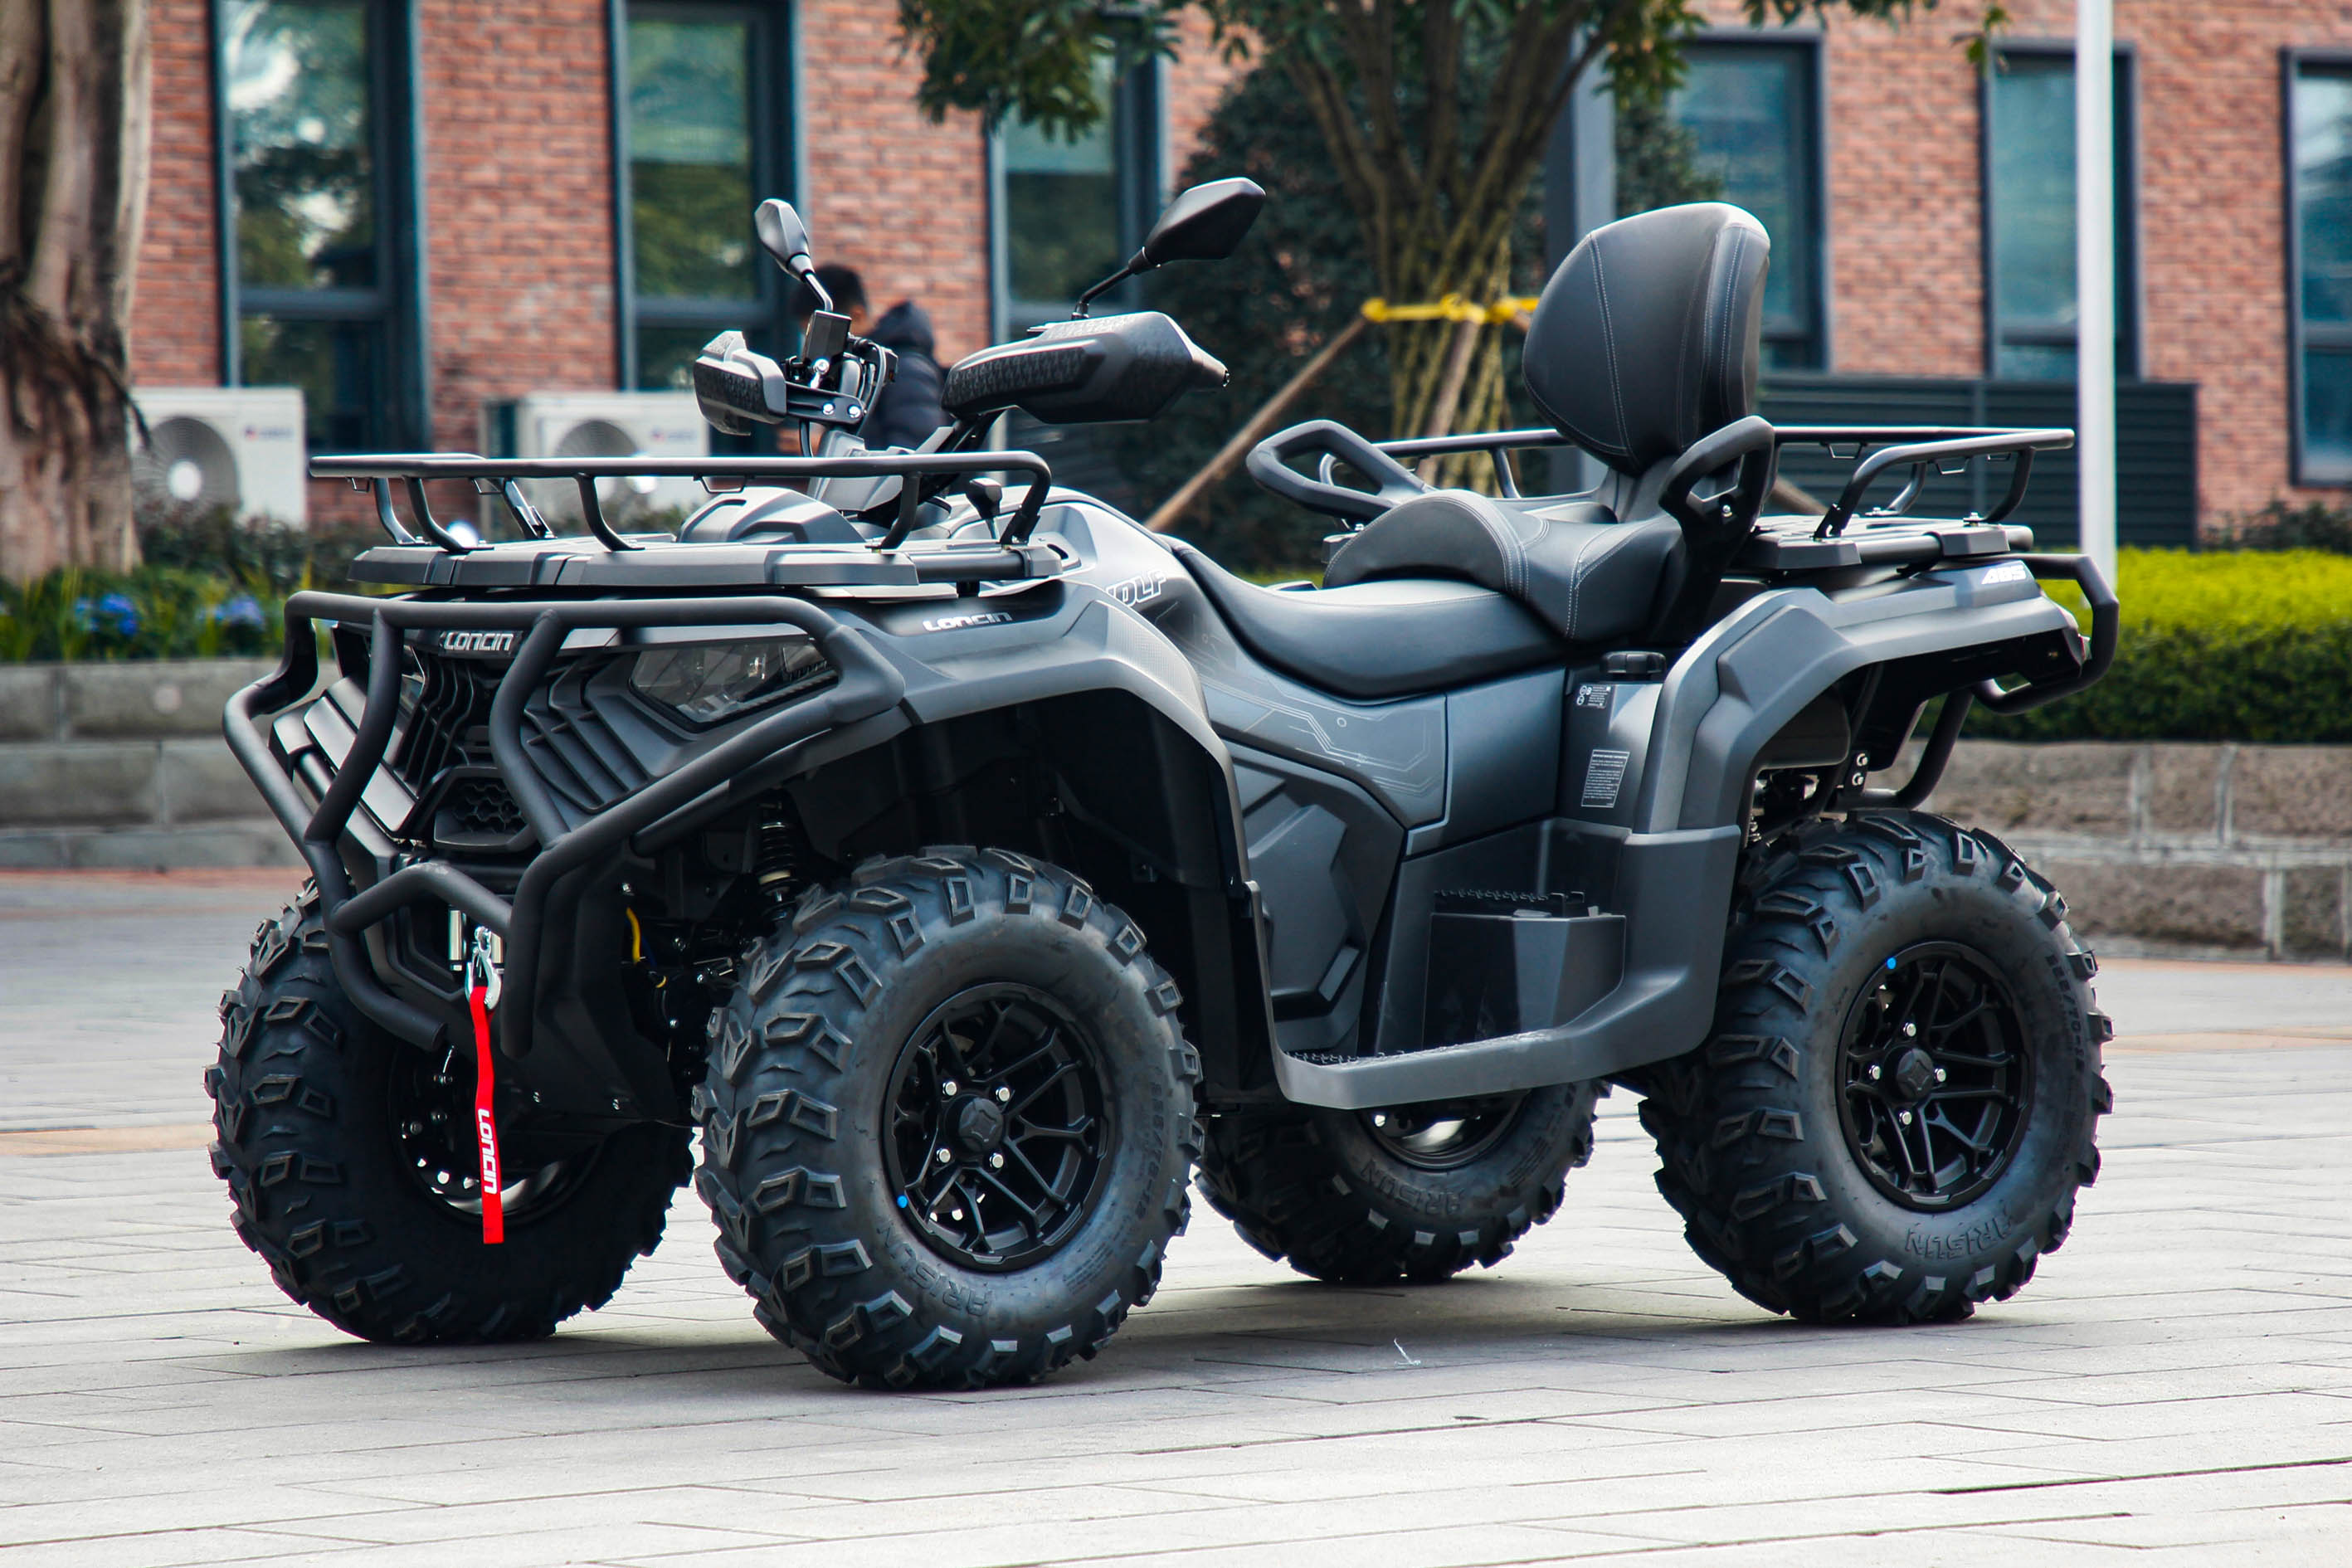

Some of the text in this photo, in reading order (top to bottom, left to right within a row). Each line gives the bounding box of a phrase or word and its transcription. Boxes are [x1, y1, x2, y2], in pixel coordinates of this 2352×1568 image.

[1106, 570, 1167, 607] OLF
[1980, 565, 2027, 585] ABS
[922, 611, 1013, 631] LONCIN
[443, 632, 514, 651] LONCIN
[478, 1108, 498, 1195] LONCIN
[1904, 1200, 2012, 1260] ARISUN
